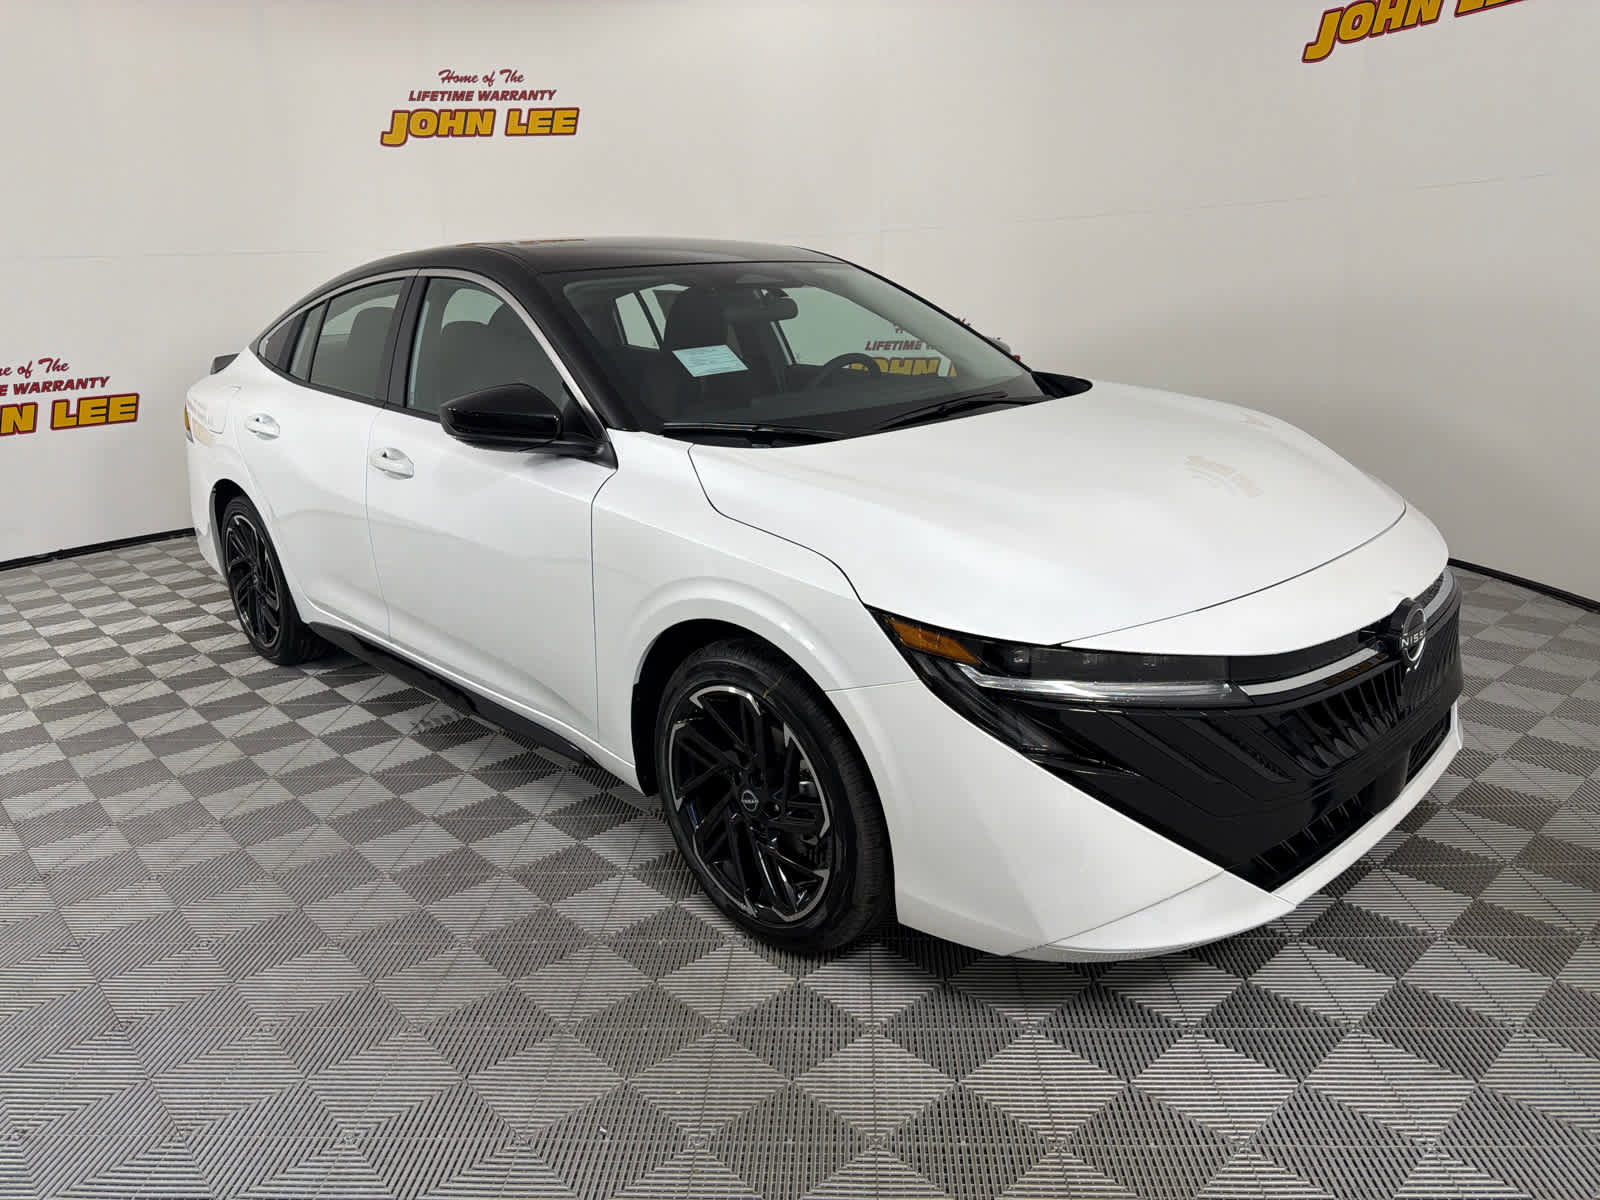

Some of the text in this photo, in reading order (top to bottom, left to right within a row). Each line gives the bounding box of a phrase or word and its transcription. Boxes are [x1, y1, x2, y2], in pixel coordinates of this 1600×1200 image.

[1301, 0, 1445, 63] JOHN
[438, 69, 525, 87] Home of The
[408, 89, 557, 102] LIFETIME WARRANTY
[380, 107, 580, 147] JOHN LEE
[17, 360, 33, 379] of
[38, 357, 70, 374] The
[13, 376, 110, 396] WARRANTY
[50, 393, 140, 431] LEE
